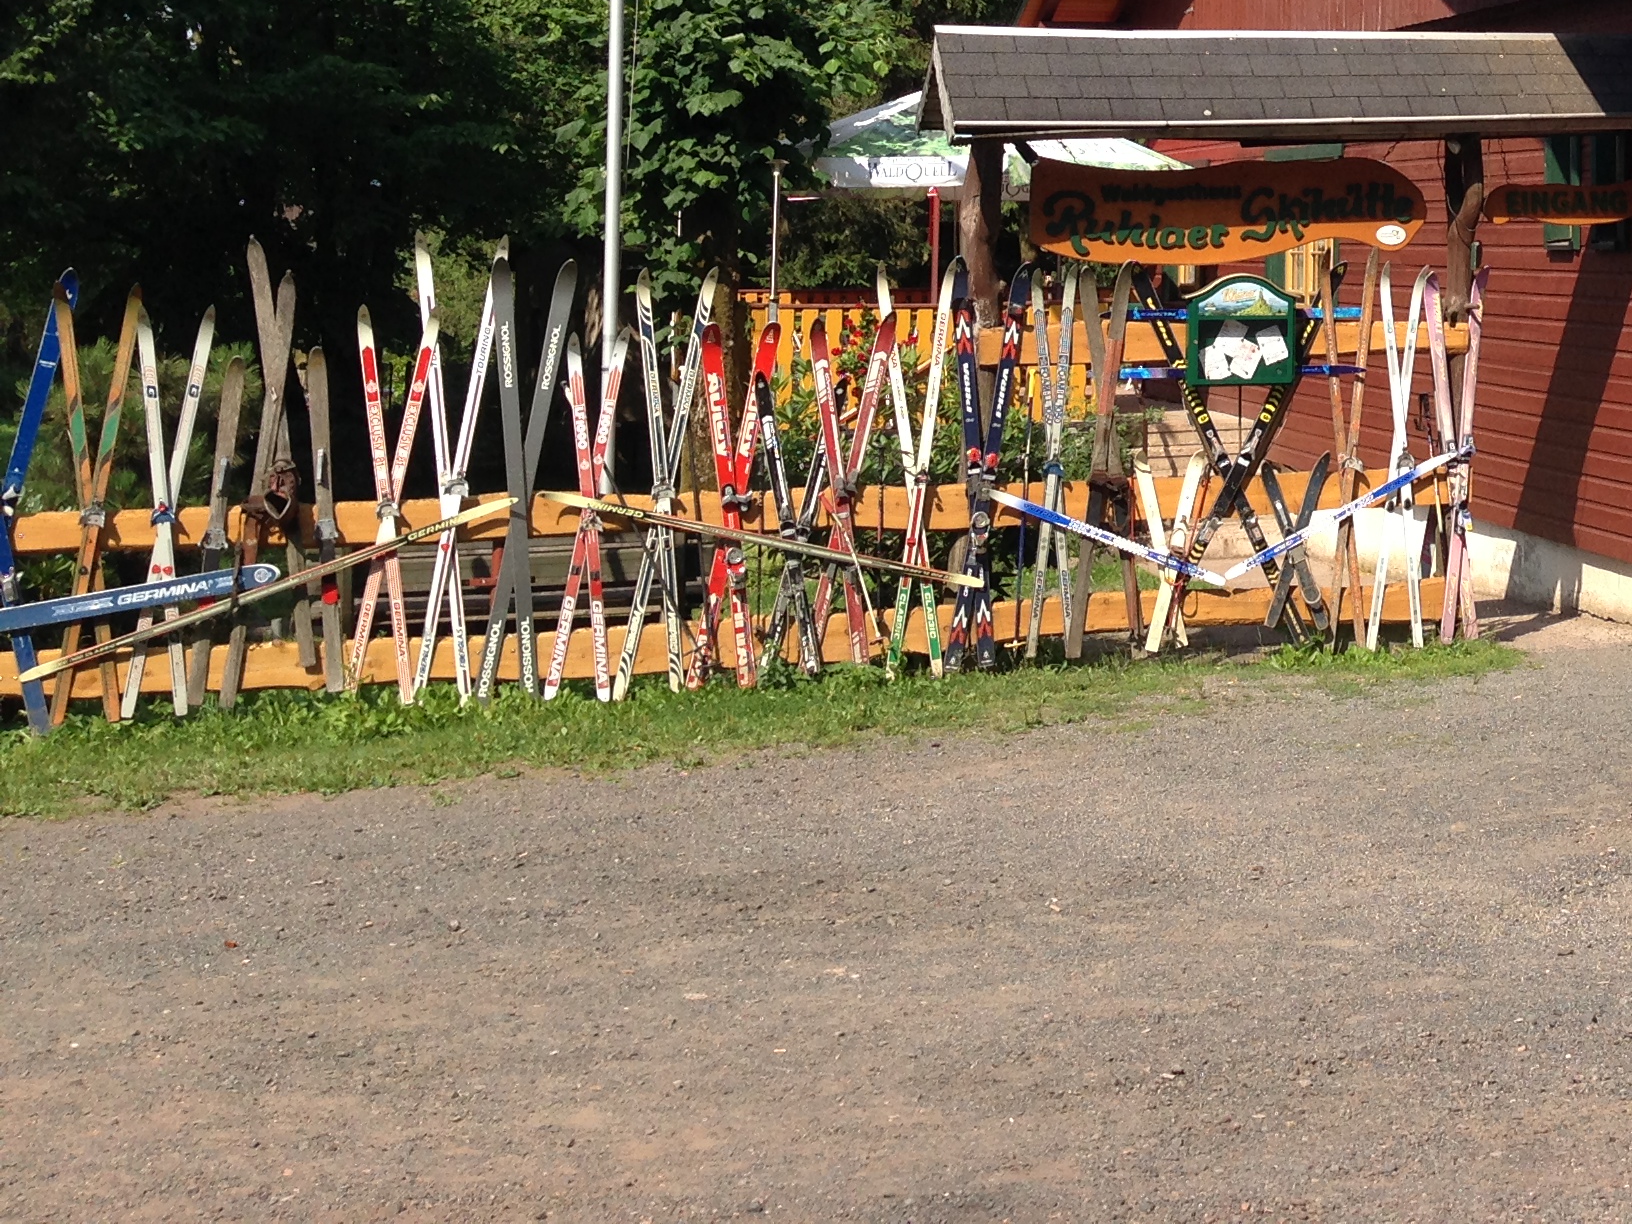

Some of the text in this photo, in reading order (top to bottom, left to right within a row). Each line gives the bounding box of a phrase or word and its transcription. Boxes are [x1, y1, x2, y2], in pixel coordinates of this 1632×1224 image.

[868, 160, 957, 183] WALDQUELL
[1506, 186, 1627, 216] EINGANG
[1043, 190, 1229, 256] Ruhlaer
[475, 326, 492, 375] TOURING
[501, 320, 513, 388] ROSSIGNOL
[541, 324, 562, 390] ROSSIGNOL
[117, 579, 209, 606] GERMINA
[478, 619, 502, 698] ROSSIGNOL
[520, 616, 534, 693] ROSSIGNOL
[549, 595, 575, 681] GERMINA
[592, 600, 608, 684] GERMINA
